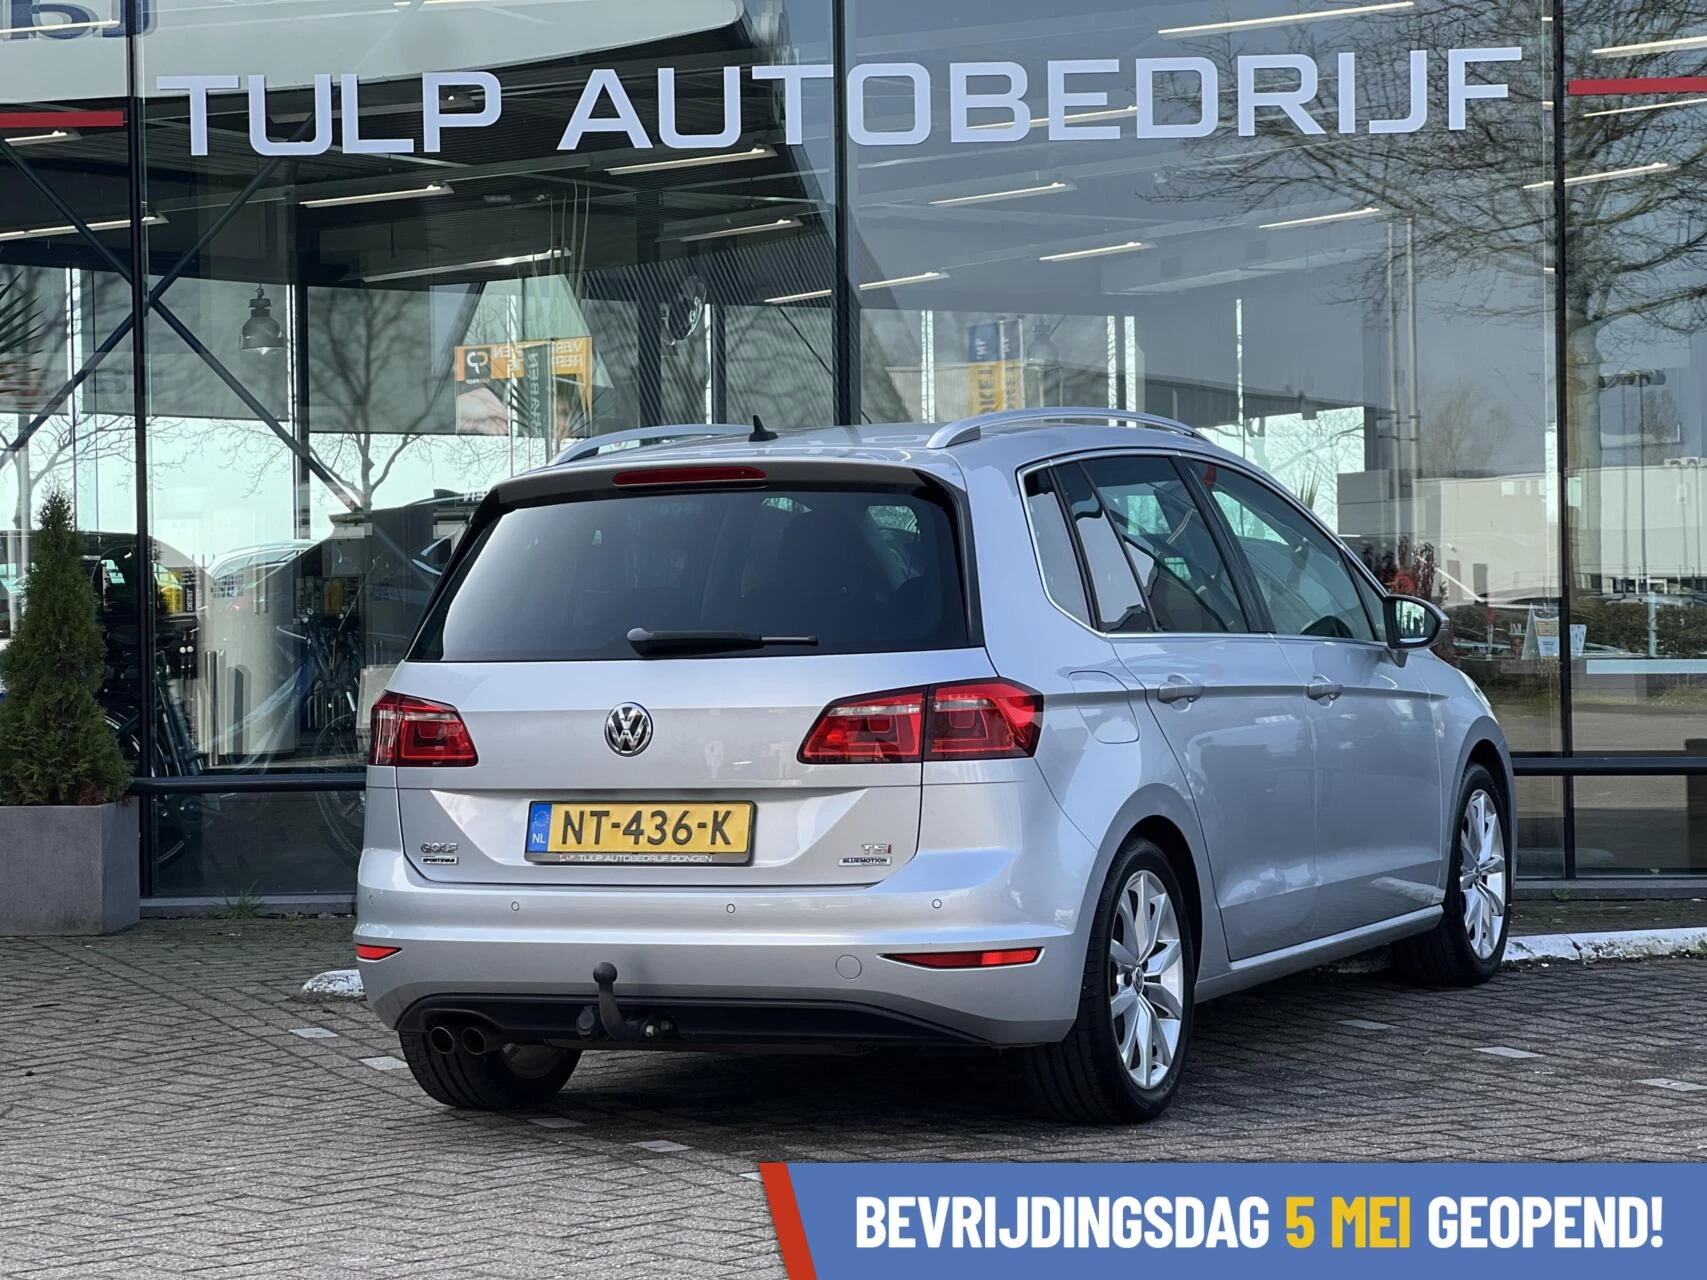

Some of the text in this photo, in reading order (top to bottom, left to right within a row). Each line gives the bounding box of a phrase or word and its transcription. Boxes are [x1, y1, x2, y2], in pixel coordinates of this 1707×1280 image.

[157, 47, 1522, 156] TULP AUTOBEDRIJF
[532, 810, 732, 846] NL NT-436-K
[421, 842, 458, 854] GOLF
[861, 843, 892, 855] TSI
[579, 855, 603, 863] TULP
[605, 855, 669, 863] AUTOBEDRIJF
[670, 855, 713, 863] DONGEN
